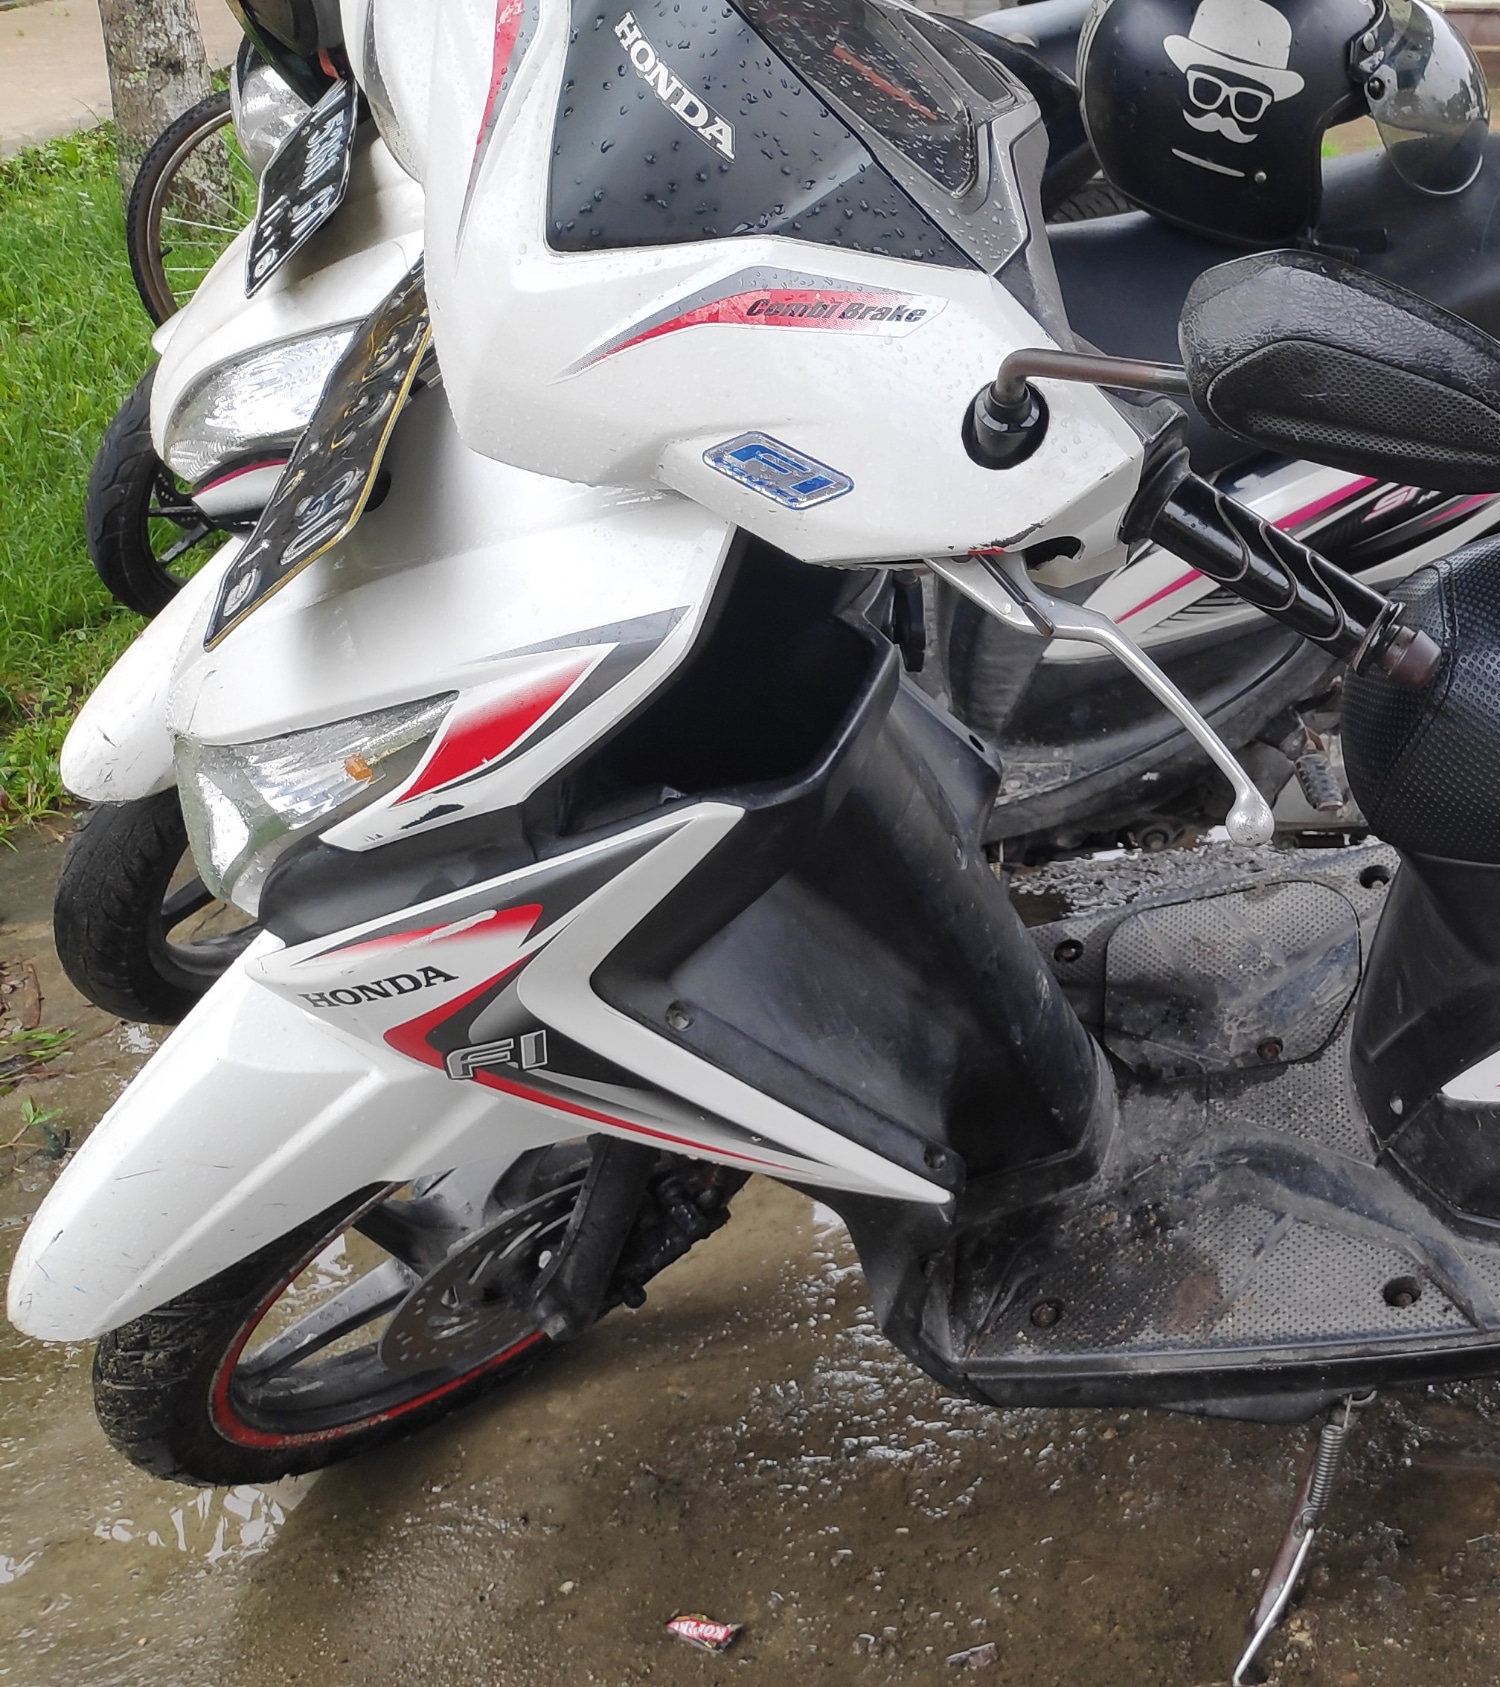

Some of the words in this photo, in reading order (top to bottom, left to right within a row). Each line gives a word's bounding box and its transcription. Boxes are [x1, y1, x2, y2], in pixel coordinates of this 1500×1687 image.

[614, 11, 736, 161] HONDA
[746, 298, 840, 319] Combi
[838, 302, 928, 323] Brake
[729, 443, 836, 495] FI
[297, 965, 460, 1008] HONDA
[445, 1029, 549, 1080] FI
